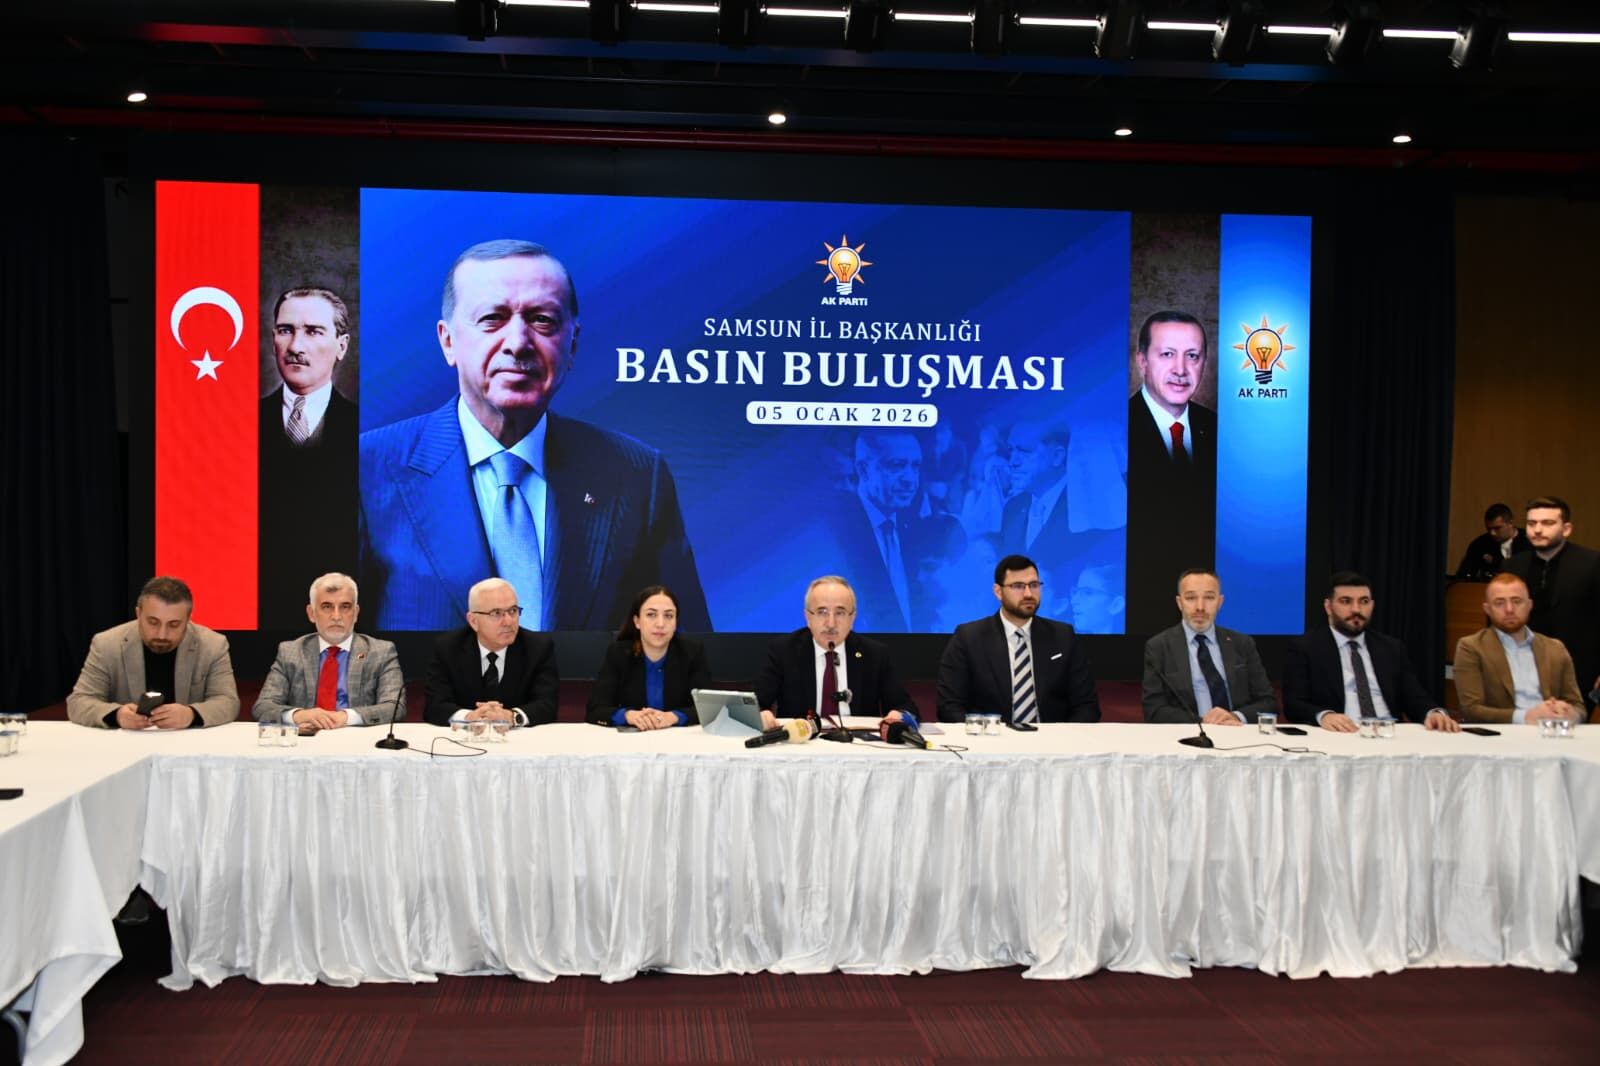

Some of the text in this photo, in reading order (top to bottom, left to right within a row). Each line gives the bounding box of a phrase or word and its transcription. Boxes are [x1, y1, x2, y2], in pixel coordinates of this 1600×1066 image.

[821, 296, 836, 306] AK
[704, 316, 981, 344] SAMSUN İL BAŞKANLIĞI
[615, 347, 1064, 398] BASIN BULUŞMASI
[1238, 387, 1254, 398] AK
[756, 406, 929, 423] 05 OCAK 2026
